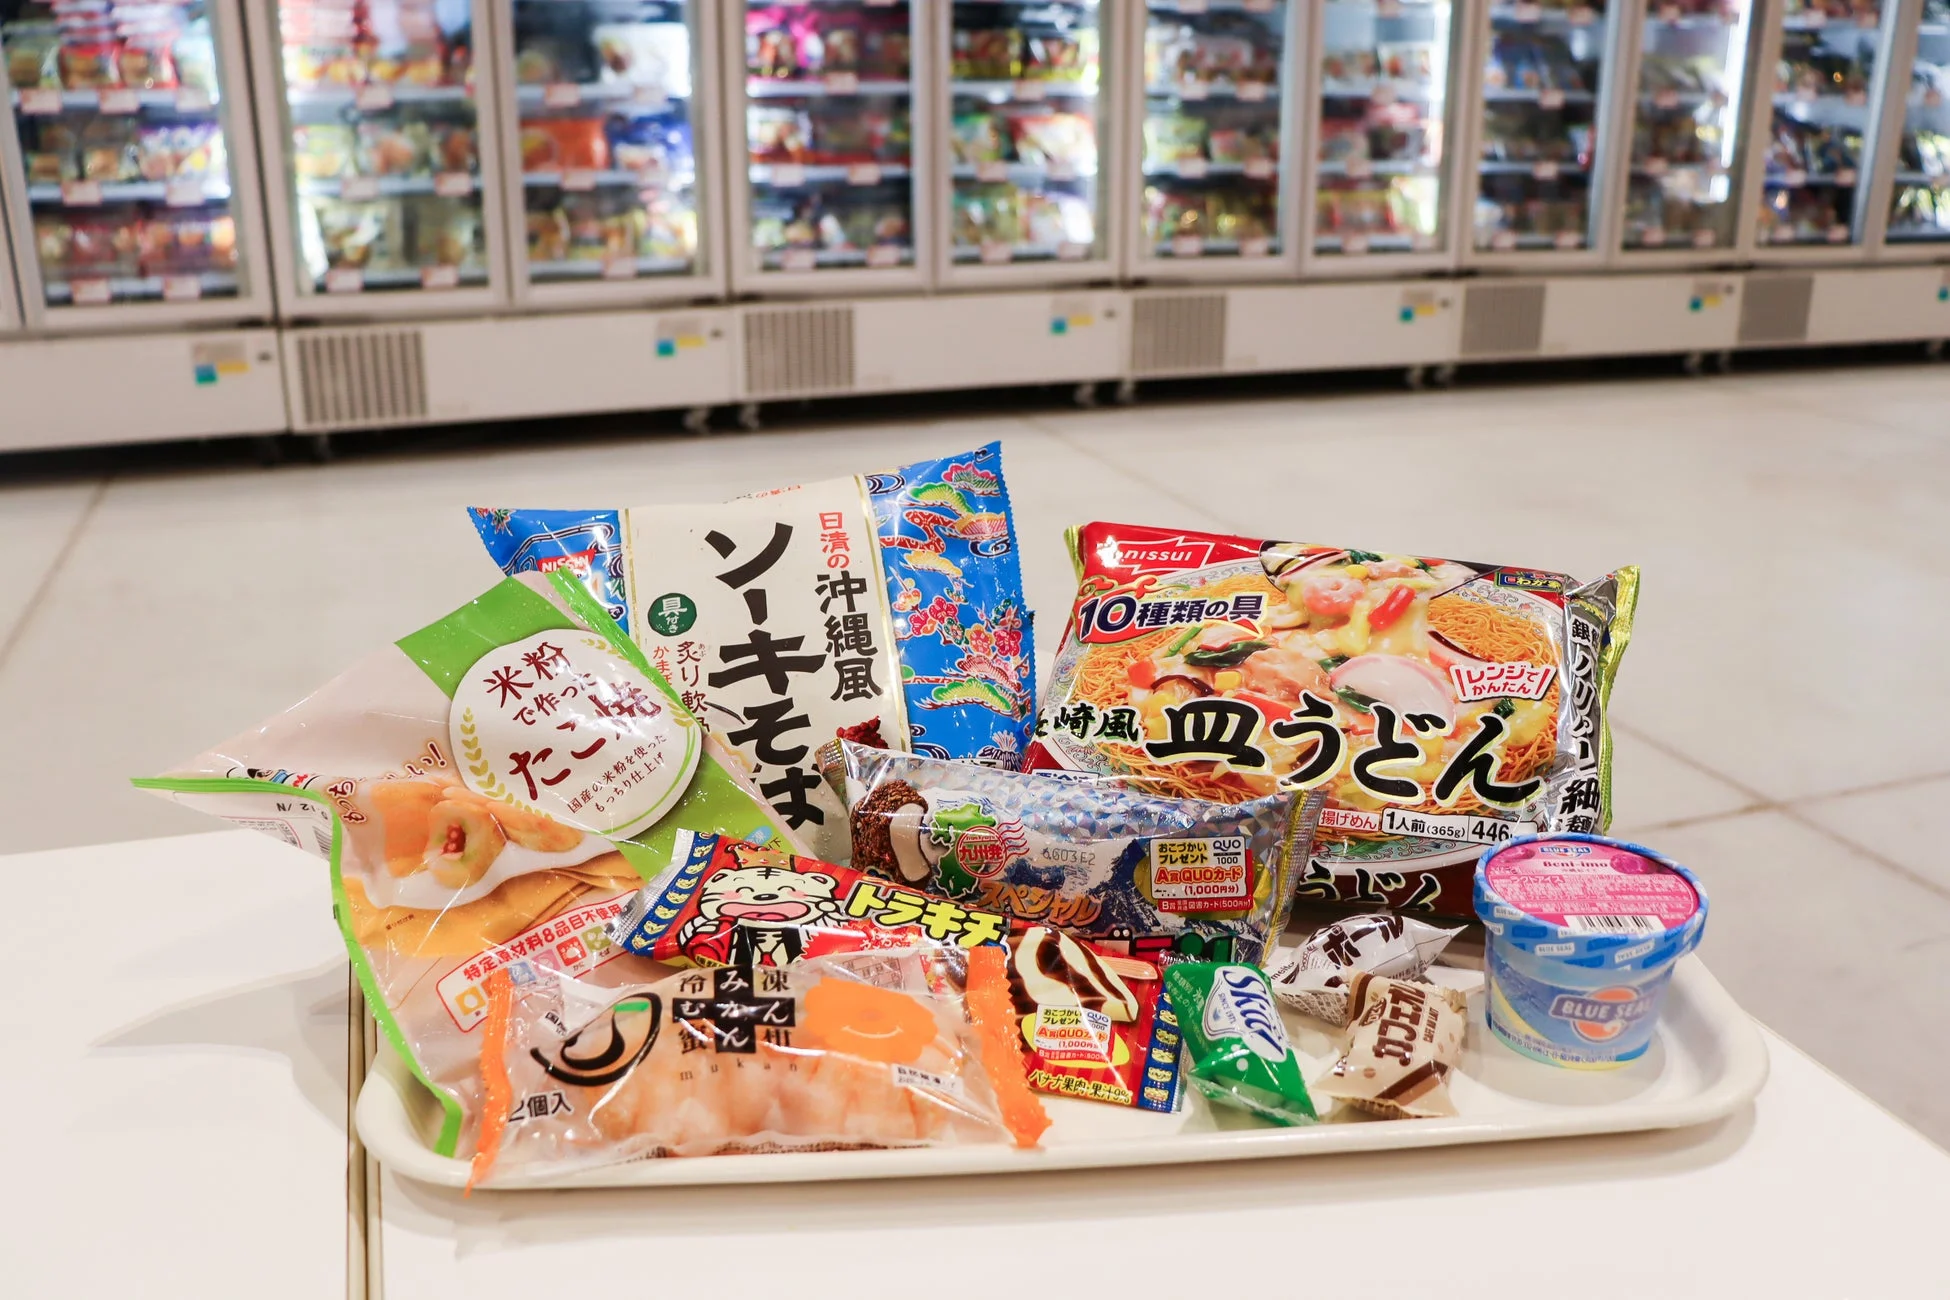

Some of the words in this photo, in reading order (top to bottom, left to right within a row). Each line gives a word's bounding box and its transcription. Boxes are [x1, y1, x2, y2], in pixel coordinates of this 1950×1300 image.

[819, 512, 851, 568] 日清の
[658, 596, 688, 633] 具付き
[1078, 595, 1263, 641] 10種類の具
[815, 570, 884, 702] 沖縄風
[483, 641, 571, 708] 米粉
[705, 522, 827, 831] ソーキそば
[1467, 665, 1539, 684] レンジで
[1473, 681, 1532, 695] かんたん
[1146, 691, 1541, 800] 皿うどん
[1321, 810, 1377, 830] 揚げめん
[959, 843, 1004, 862] 九州発
[1158, 842, 1208, 854] おこづかい
[1213, 839, 1242, 852] QUO
[1158, 853, 1208, 865] プレゼント
[1217, 856, 1239, 865] 1000
[1184, 884, 1239, 896] (1,000円分)
[978, 880, 1100, 926] スペシャル
[1087, 1011, 1109, 1023] QUO
[1561, 1000, 1611, 1019] BLUE
[1043, 1016, 1082, 1025] プレゼント
